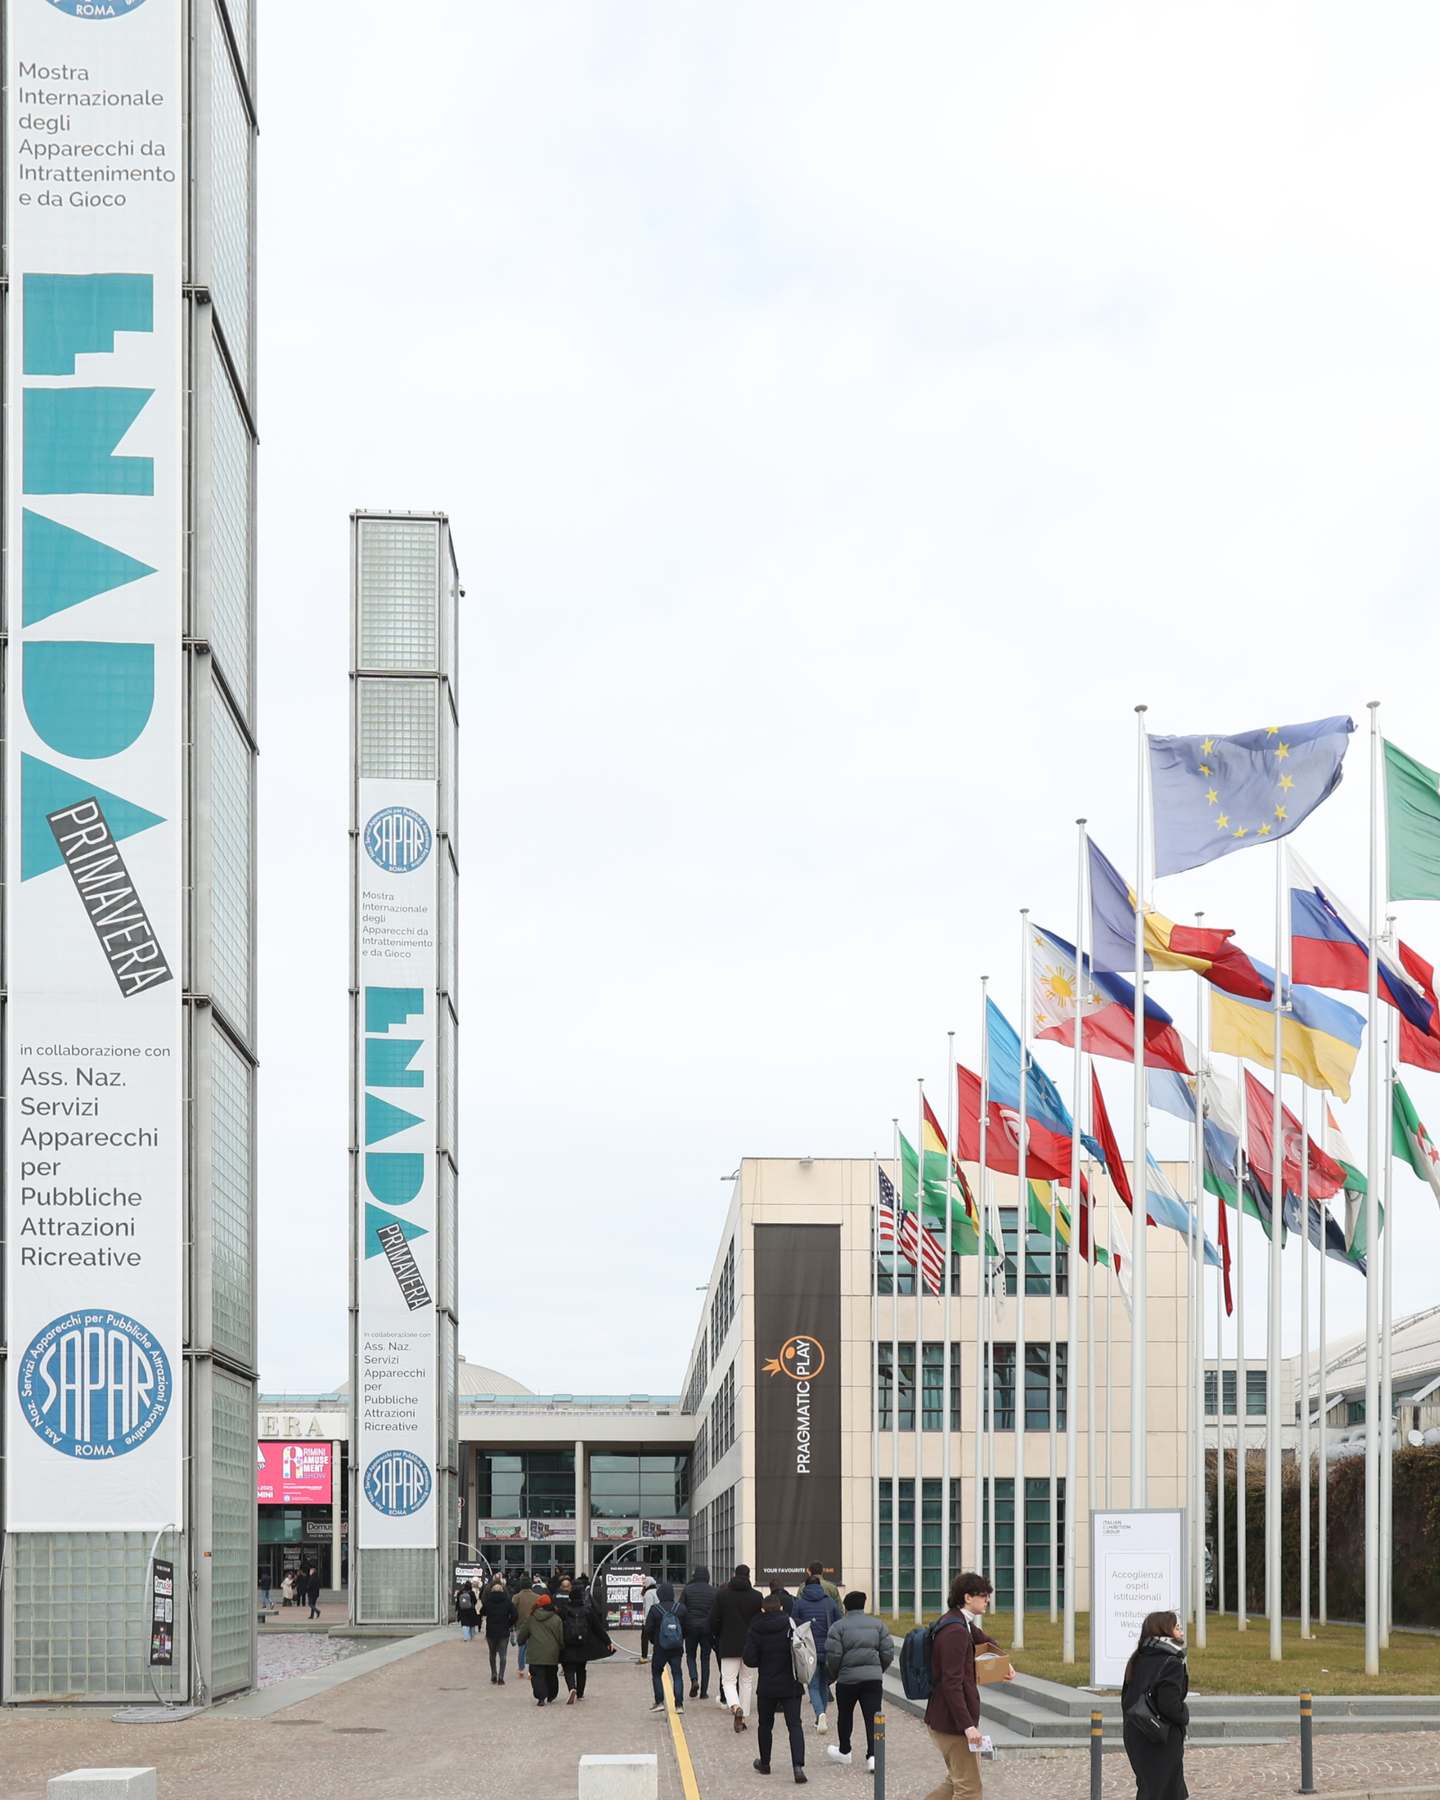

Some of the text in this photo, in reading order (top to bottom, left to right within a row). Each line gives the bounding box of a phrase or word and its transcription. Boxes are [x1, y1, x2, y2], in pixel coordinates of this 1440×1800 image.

[76, 5, 116, 16] ROMA
[18, 61, 90, 81] Mostra
[18, 87, 164, 106] Internazionale
[18, 113, 71, 135] degli
[18, 139, 166, 160] Apparecchi da
[18, 164, 176, 182] Intrattenimento
[18, 190, 127, 208] e da Gioco
[373, 814, 425, 866] SAPAR
[49, 800, 168, 996] PRIMAVERA
[362, 891, 394, 901] Mostra
[362, 903, 428, 913] Internazionale
[362, 914, 386, 923] degli
[362, 926, 429, 936] Apparecchi da
[362, 937, 433, 947] Intrattenimento
[370, 949, 382, 957] da
[385, 949, 411, 958] Gioco
[20, 1043, 171, 1057] in collaborazione con
[20, 1067, 127, 1087] Ass. Naz.
[20, 1096, 99, 1116] Servizi
[20, 1126, 158, 1151] Apparecchi
[20, 1161, 61, 1181] per
[21, 1186, 143, 1207] Pubbliche
[20, 1217, 135, 1236] Attrazioni
[21, 1247, 142, 1267] Ricreative
[378, 1223, 430, 1310] PRIMAVERA
[364, 1342, 411, 1351] Ass. Naz.
[364, 1355, 399, 1364] Servizi
[21, 1313, 169, 1446] Ass. Naz. Servizi Apparecchi per Pubbliche Attrazioni Ricreative
[364, 1369, 425, 1379] Apparecchi
[38, 1326, 155, 1443] SAPAR
[364, 1383, 382, 1392] per
[364, 1395, 418, 1404] Pubbliche
[797, 1339, 810, 1474] PRAGMATIC PLAY
[364, 1409, 415, 1418] Attrazioni
[364, 1422, 418, 1431] Ricreative
[75, 1444, 115, 1456] ROMA
[373, 1458, 424, 1509] SAPAR
[1112, 1570, 1163, 1580] Accoglienza
[1126, 1582, 1149, 1591] ospiti
